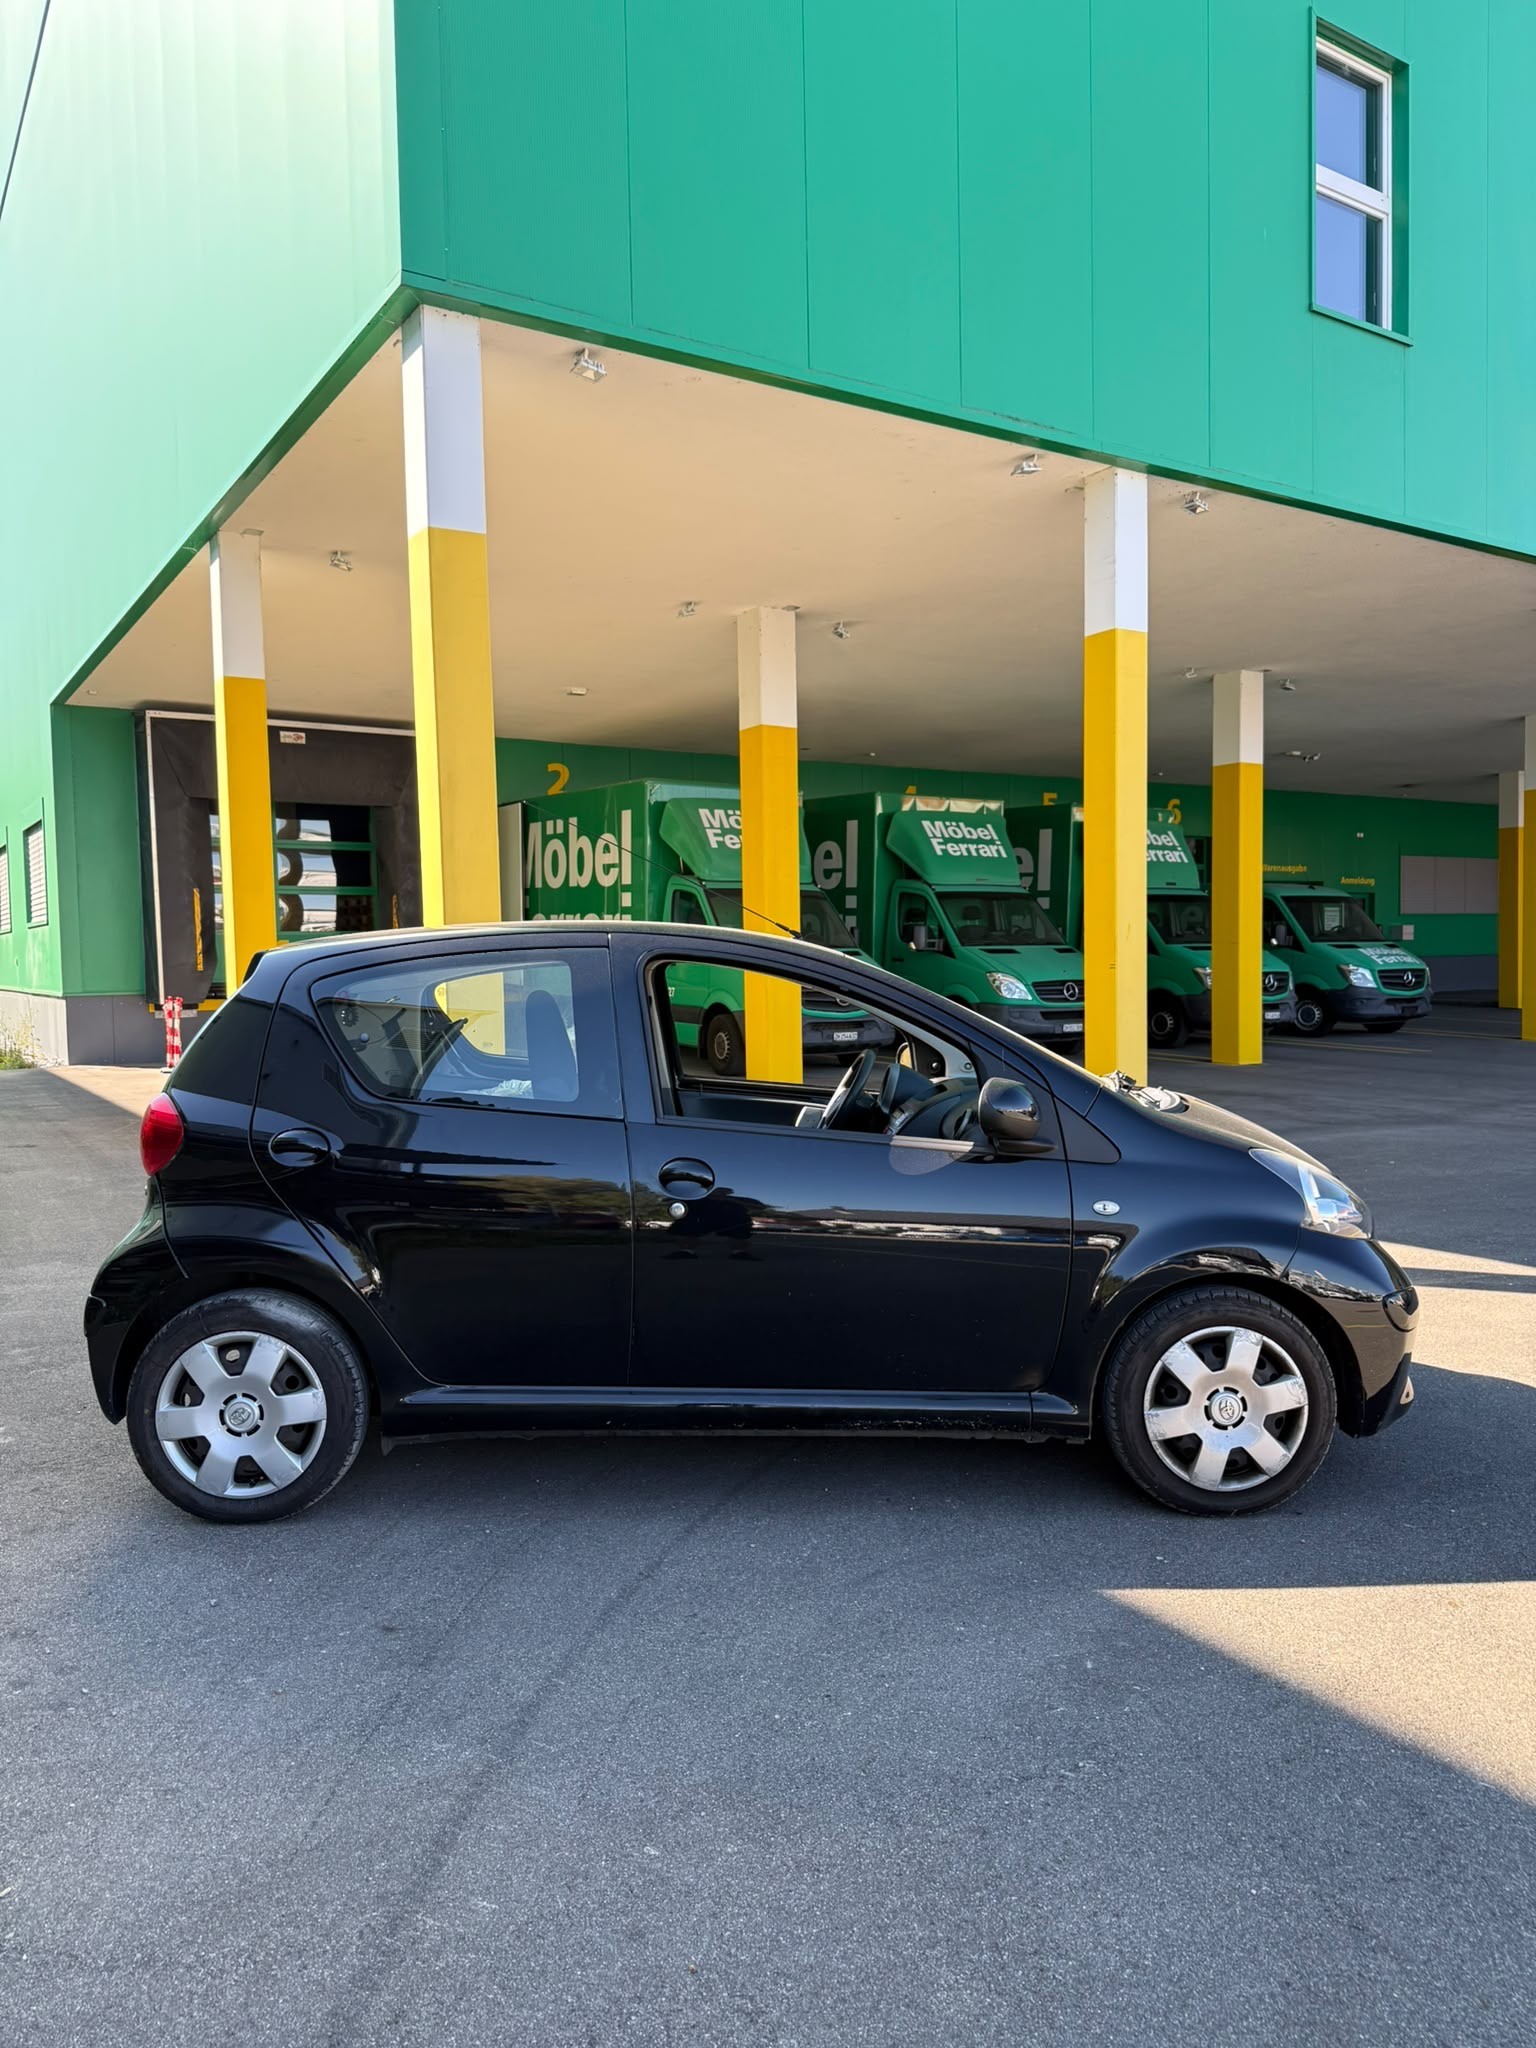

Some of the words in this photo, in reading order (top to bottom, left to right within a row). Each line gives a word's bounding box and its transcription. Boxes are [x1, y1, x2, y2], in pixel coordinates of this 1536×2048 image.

[547, 762, 570, 796] 2
[921, 819, 999, 841] Möbel
[930, 837, 1008, 858] Ferrari
[1340, 876, 1376, 887] Anmeldung
